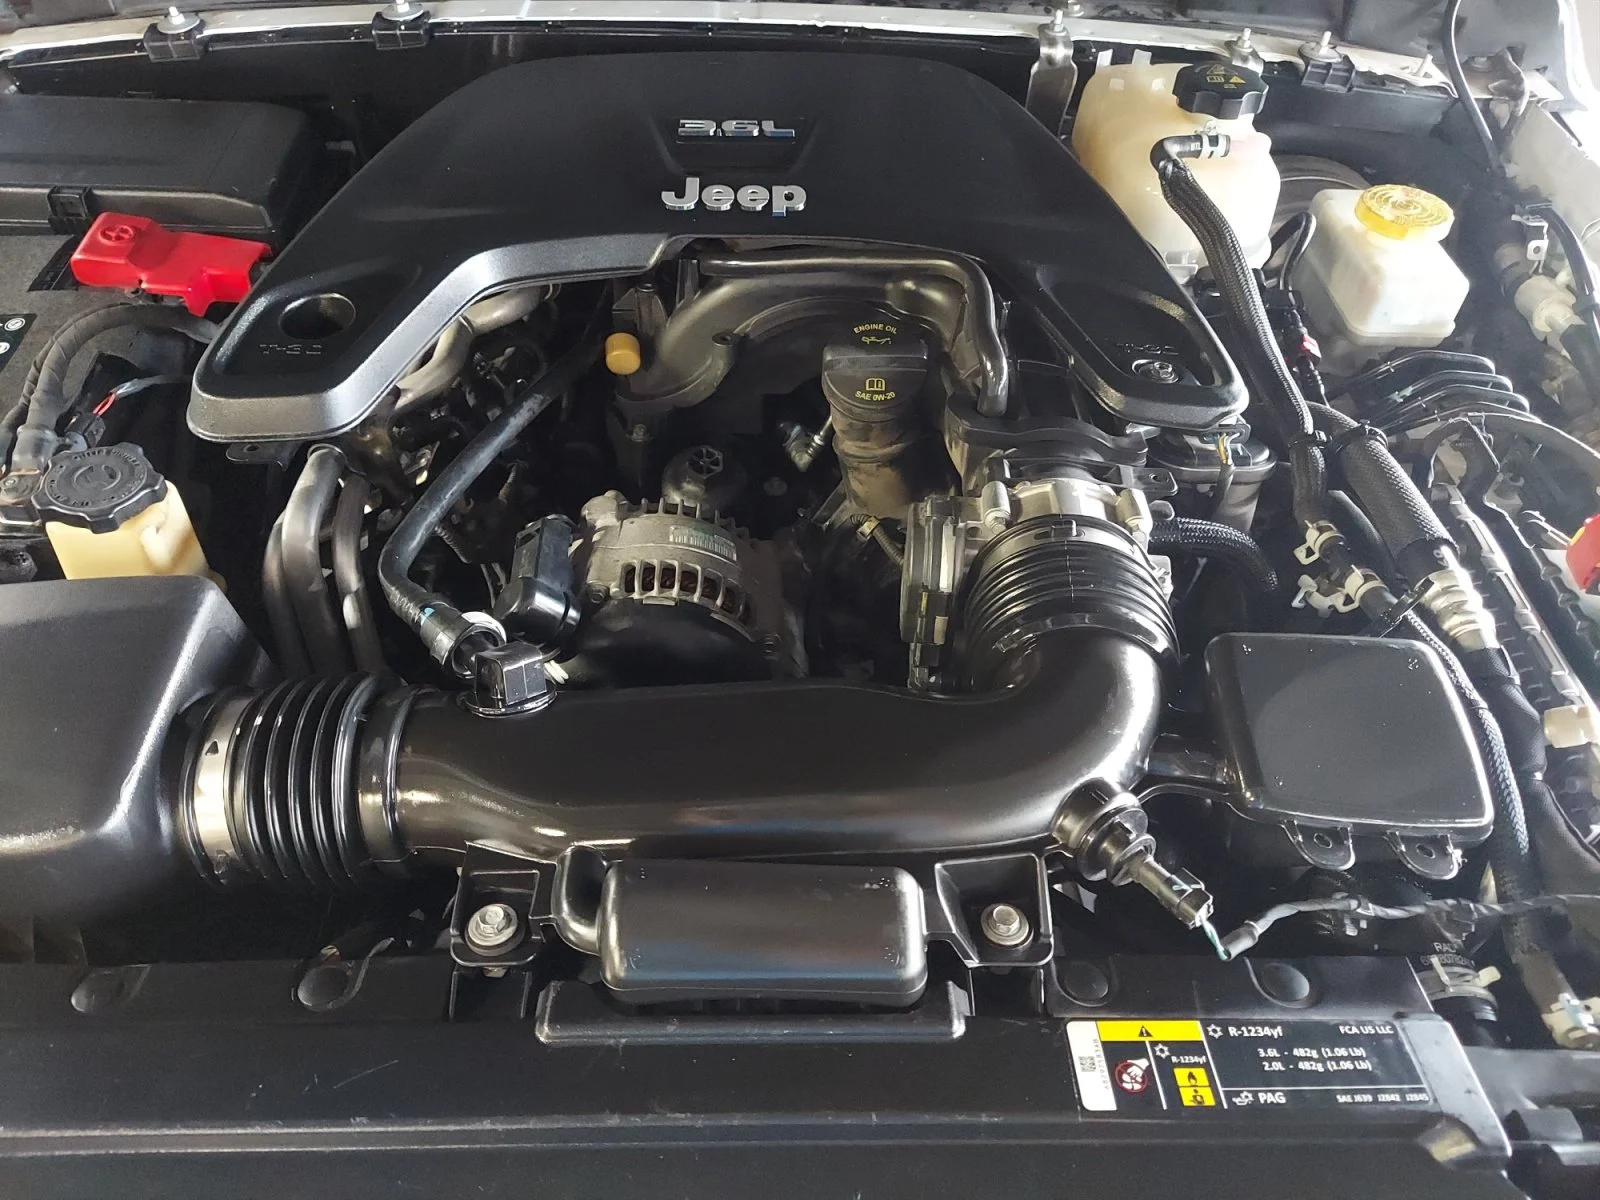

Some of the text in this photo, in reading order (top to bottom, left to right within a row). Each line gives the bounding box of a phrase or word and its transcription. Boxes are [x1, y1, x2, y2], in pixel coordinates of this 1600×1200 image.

[678, 119, 796, 138] 3.6L
[661, 177, 807, 217] Jeep
[853, 323, 897, 335] ENGINE OIL
[855, 390, 871, 401] SAE
[1228, 1026, 1283, 1039] R-1234yf
[1339, 1025, 1394, 1034] FCA US LLC
[1257, 1048, 1280, 1058] 3.6L
[1293, 1047, 1319, 1059] 482g
[1321, 1047, 1348, 1058] (1.06
[1349, 1047, 1366, 1058] Lb)
[1262, 1061, 1286, 1071] 2.0L
[1298, 1061, 1324, 1073] 482g
[1326, 1060, 1354, 1072] (1.06
[1355, 1060, 1372, 1072] Lb)
[1258, 1091, 1287, 1104] PAG
